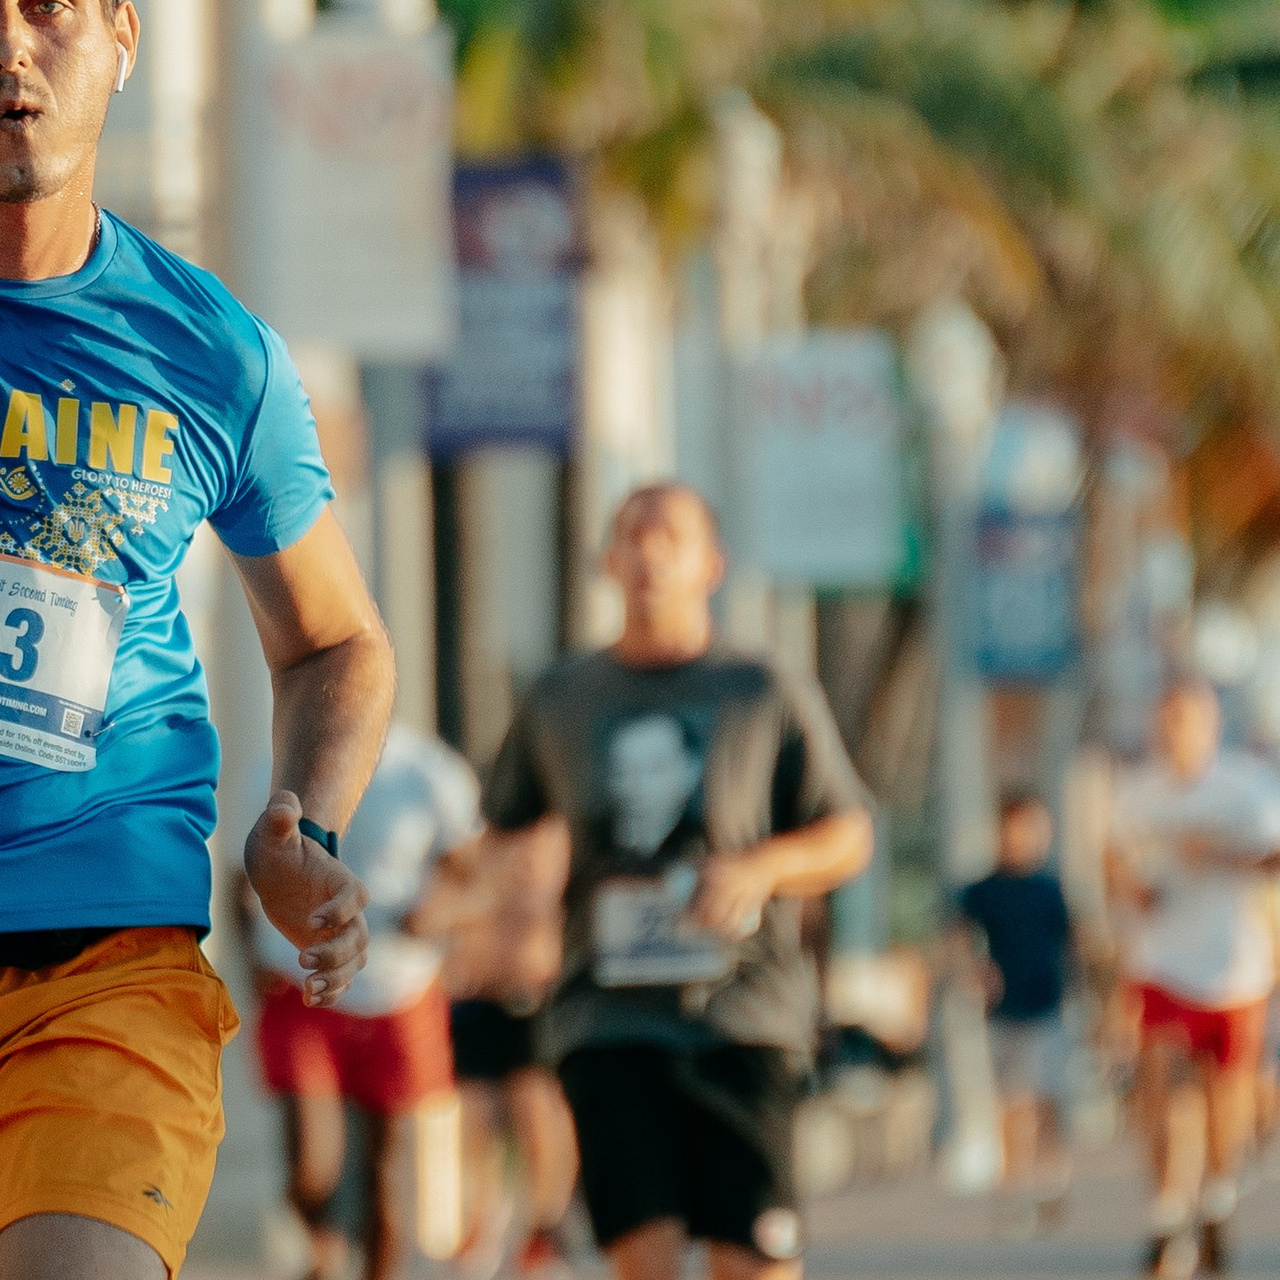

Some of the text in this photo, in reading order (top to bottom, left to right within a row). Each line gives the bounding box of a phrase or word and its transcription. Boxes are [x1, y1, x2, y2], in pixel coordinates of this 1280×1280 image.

[71, 469, 172, 500] GLORY TO HEROES!
[8, 582, 47, 603] Second
[50, 591, 79, 617] Timing
[6, 730, 16, 738] for
[33, 737, 43, 746] off
